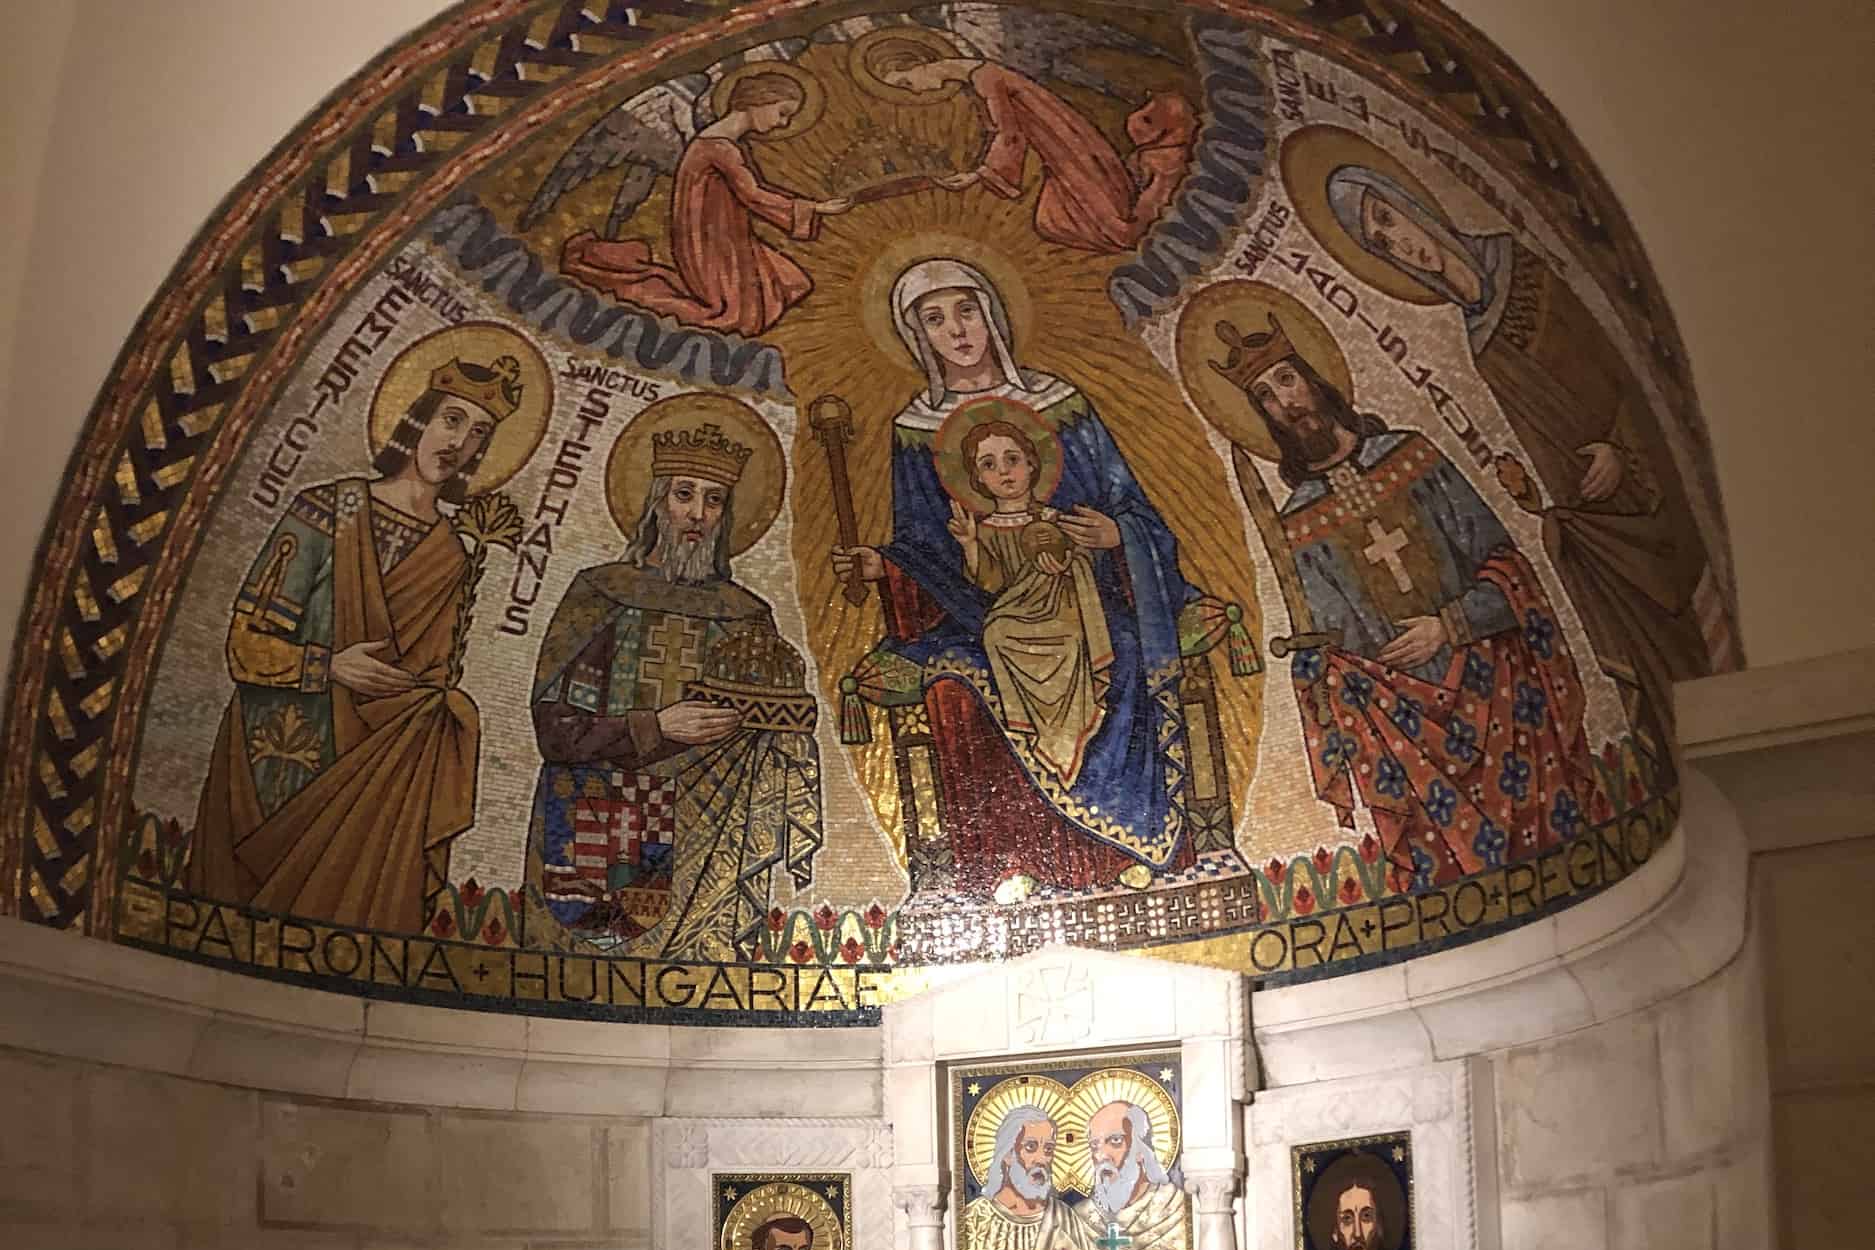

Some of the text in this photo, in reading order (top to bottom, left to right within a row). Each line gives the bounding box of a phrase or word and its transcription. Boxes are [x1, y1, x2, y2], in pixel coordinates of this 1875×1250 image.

[1271, 49, 1304, 120] SANCTA
[1235, 201, 1289, 276] SANCTUS
[384, 256, 469, 322] SANCTUS
[254, 285, 412, 509] EMERICUS
[559, 356, 660, 401] SANCTUS
[1272, 252, 1493, 470] LADISLAUS
[499, 388, 612, 636] STEPHANUS
[165, 895, 463, 994] PATRONA
[1250, 913, 1365, 972] ORA
[1380, 881, 1488, 951] PRO
